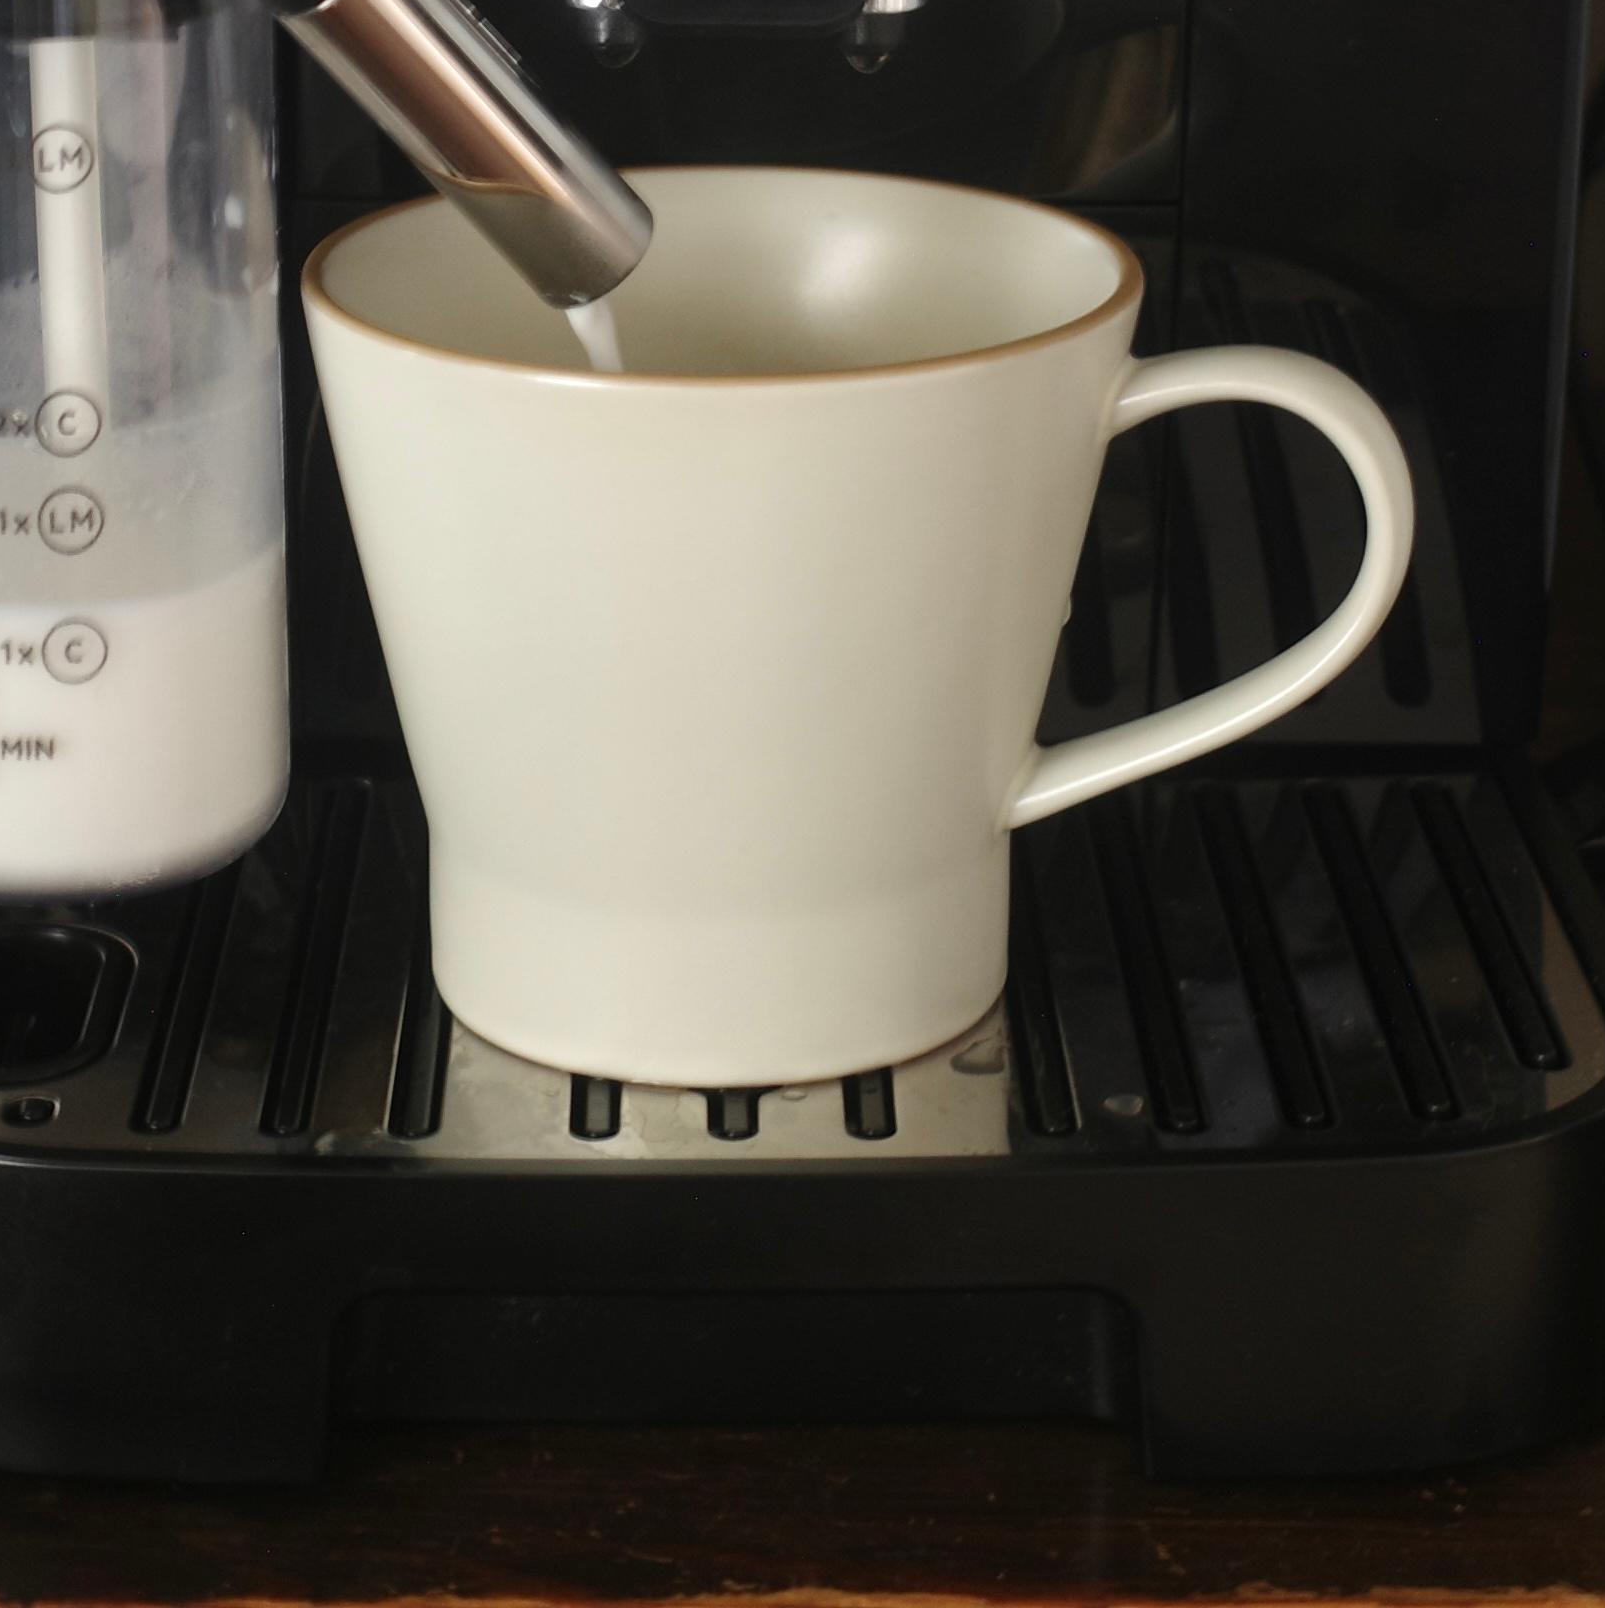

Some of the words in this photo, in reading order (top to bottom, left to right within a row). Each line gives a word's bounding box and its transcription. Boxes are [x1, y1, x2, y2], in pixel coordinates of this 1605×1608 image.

[39, 146, 84, 173] LM
[49, 506, 95, 535] LM
[0, 639, 35, 666] 1x
[0, 738, 55, 760] MIN
